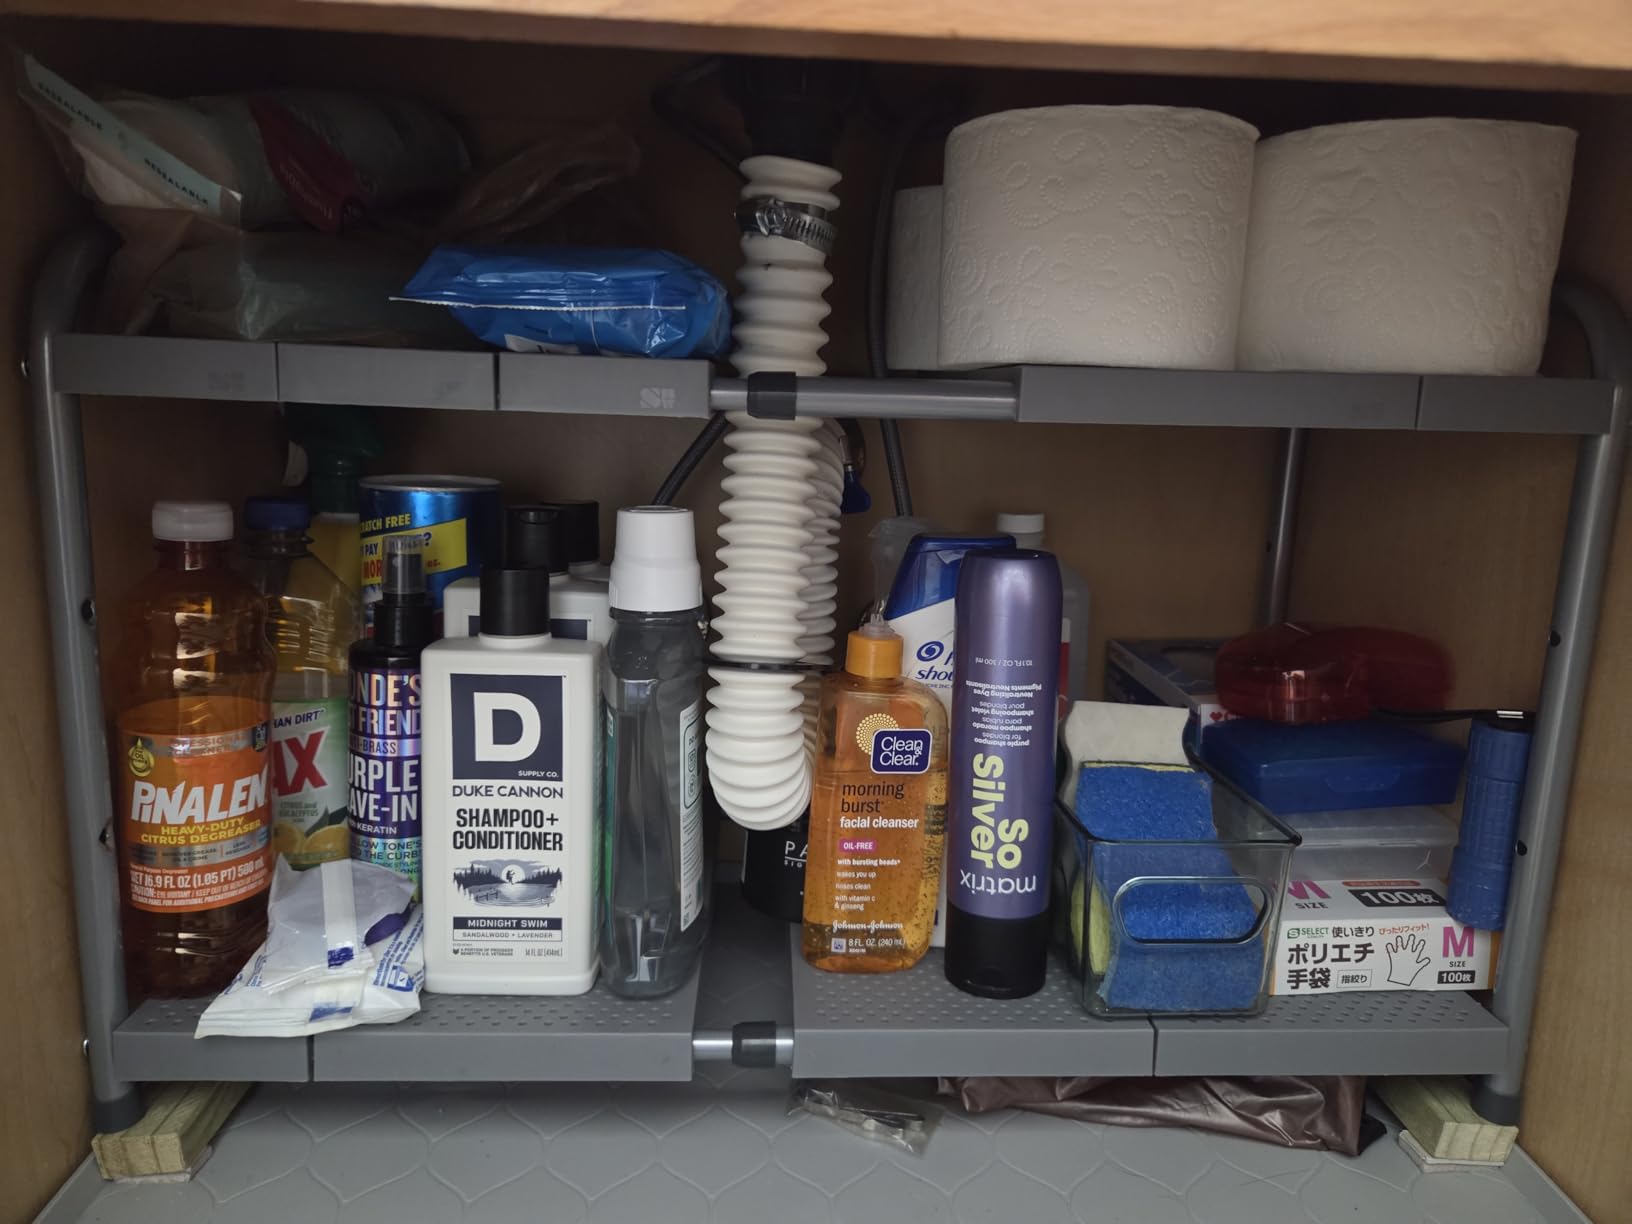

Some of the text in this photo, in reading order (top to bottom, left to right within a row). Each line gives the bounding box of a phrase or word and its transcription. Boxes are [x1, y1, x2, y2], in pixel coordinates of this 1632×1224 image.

[385, 514, 411, 528] FREE
[295, 710, 319, 725] DIRT
[474, 692, 541, 762] D
[881, 736, 924, 752] Clean
[914, 747, 922, 757] &
[518, 770, 545, 778] SUPPLY
[452, 785, 564, 799] DUKE CANNON
[842, 781, 905, 799] morning
[841, 799, 881, 813] burst
[970, 753, 1006, 869] Silver
[161, 817, 245, 836] HEAVY-DUTY
[357, 822, 397, 835] KERATIN
[840, 816, 919, 829] facial cleanser
[141, 819, 262, 845] CITRUS DEGREASER
[453, 830, 563, 851] CONDITIONER
[843, 842, 873, 850] OIL-FREE
[996, 818, 1029, 869] So
[852, 858, 878, 867] bursting
[144, 874, 163, 888] 16.9
[164, 876, 176, 889] FL
[177, 875, 191, 888] OZ
[193, 872, 218, 888] (1.05
[220, 866, 236, 883] PT)
[960, 869, 1037, 896] matrix
[467, 919, 548, 928] MIDNIGHT SWIM
[1301, 927, 1329, 936] SELECT
[1332, 926, 1375, 938] 使いきり
[1443, 926, 1475, 958] M
[1288, 943, 1375, 965] ポリエチ
[1287, 967, 1331, 990] 手袋
[1441, 972, 1472, 983] 100枚
